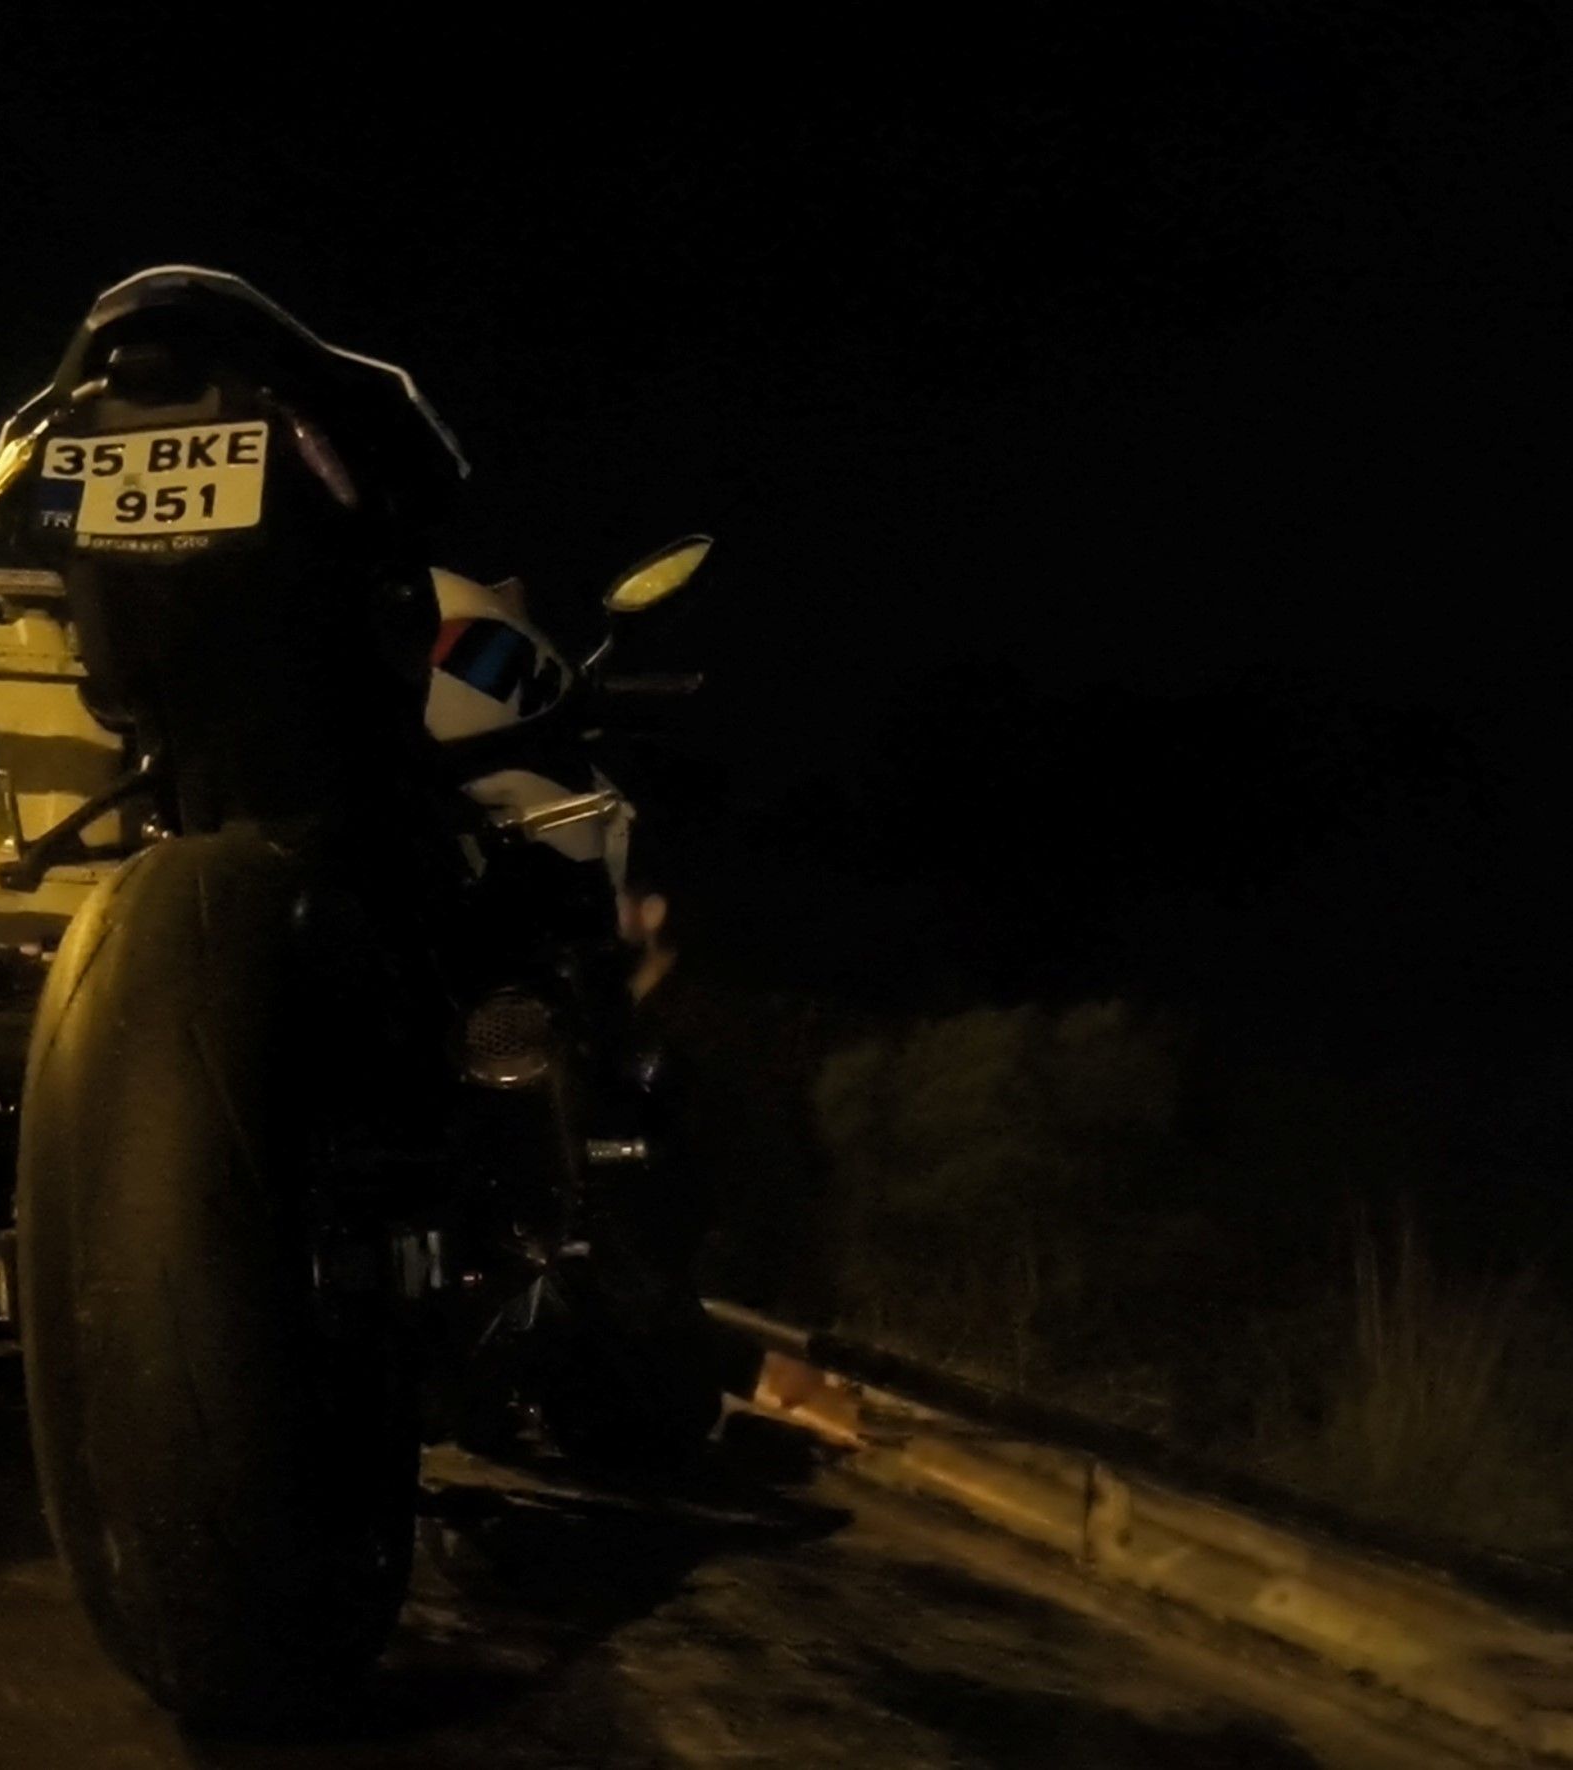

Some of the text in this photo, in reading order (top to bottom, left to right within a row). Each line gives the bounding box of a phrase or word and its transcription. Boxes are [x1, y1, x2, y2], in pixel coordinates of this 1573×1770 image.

[51, 430, 264, 477] 35 BKE
[40, 510, 73, 528] TR
[115, 483, 217, 524] 951
